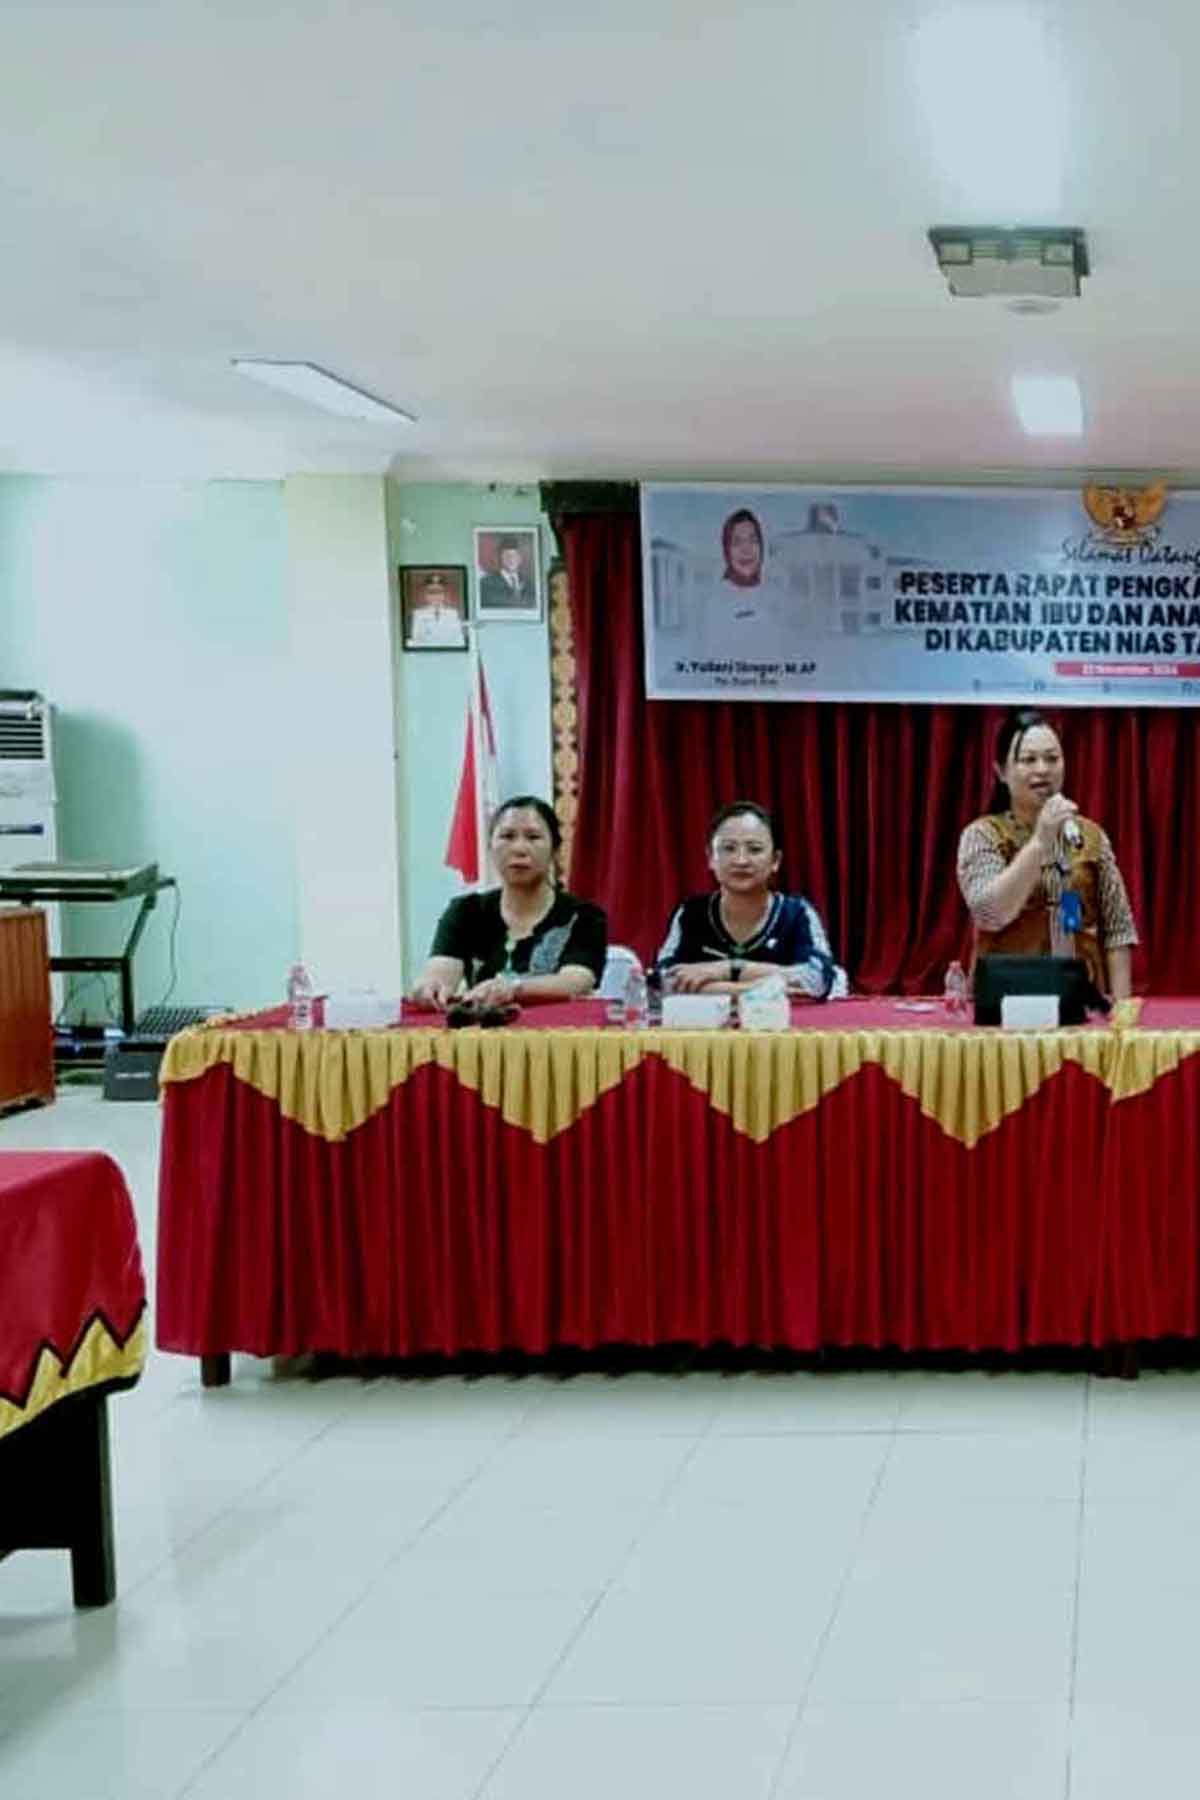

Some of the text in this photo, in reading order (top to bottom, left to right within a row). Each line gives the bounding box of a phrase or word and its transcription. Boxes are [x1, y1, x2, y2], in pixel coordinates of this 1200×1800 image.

[901, 571, 1010, 596] PESERTA
[1015, 573, 1100, 597] RAPAT
[895, 598, 1031, 624] KEMATIAN
[1041, 602, 1082, 625] IBU
[1087, 603, 1143, 626] DAN
[925, 628, 950, 650] DI
[956, 629, 1110, 653] KABUPATEN
[1115, 631, 1176, 654] NIAS
